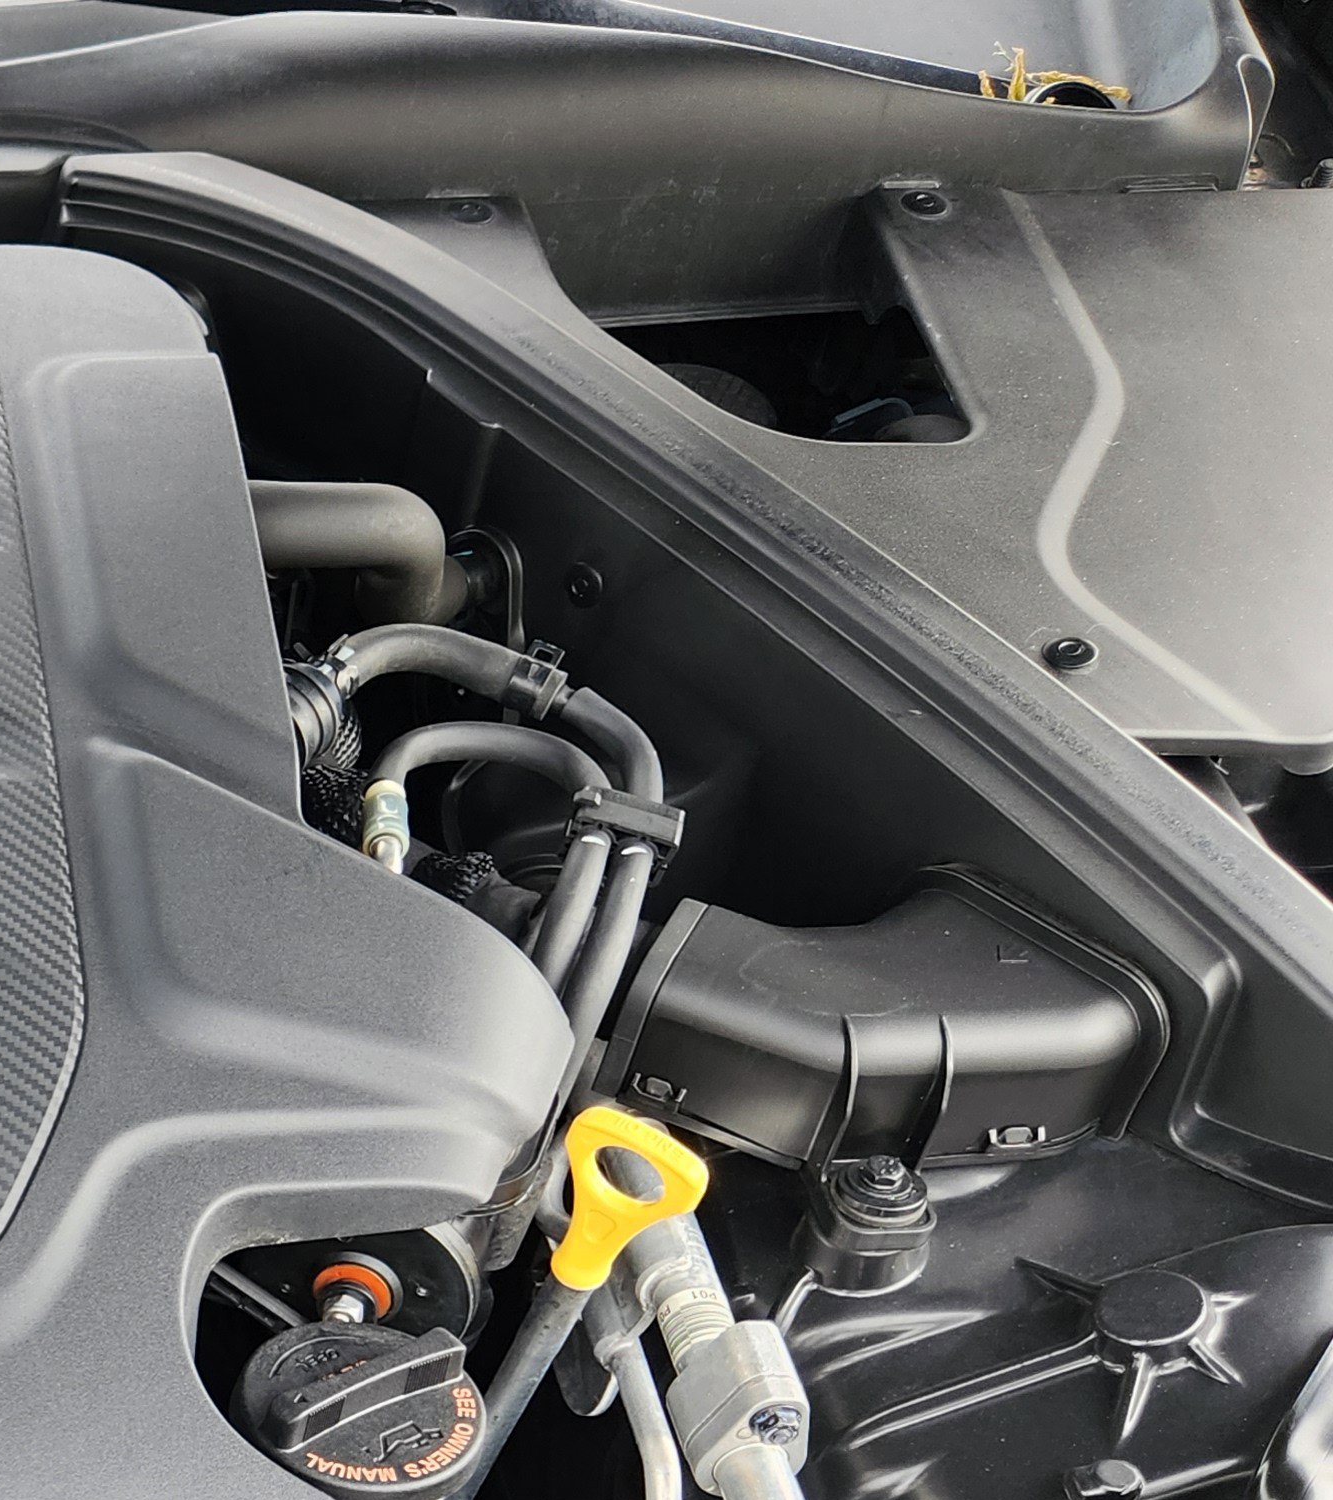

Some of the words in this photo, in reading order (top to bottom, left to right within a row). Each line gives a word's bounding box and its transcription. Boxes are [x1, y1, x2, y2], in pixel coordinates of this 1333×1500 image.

[451, 1387, 477, 1419] SEE
[402, 1422, 475, 1479] OWNER'S
[305, 1451, 398, 1483] MANUAL
